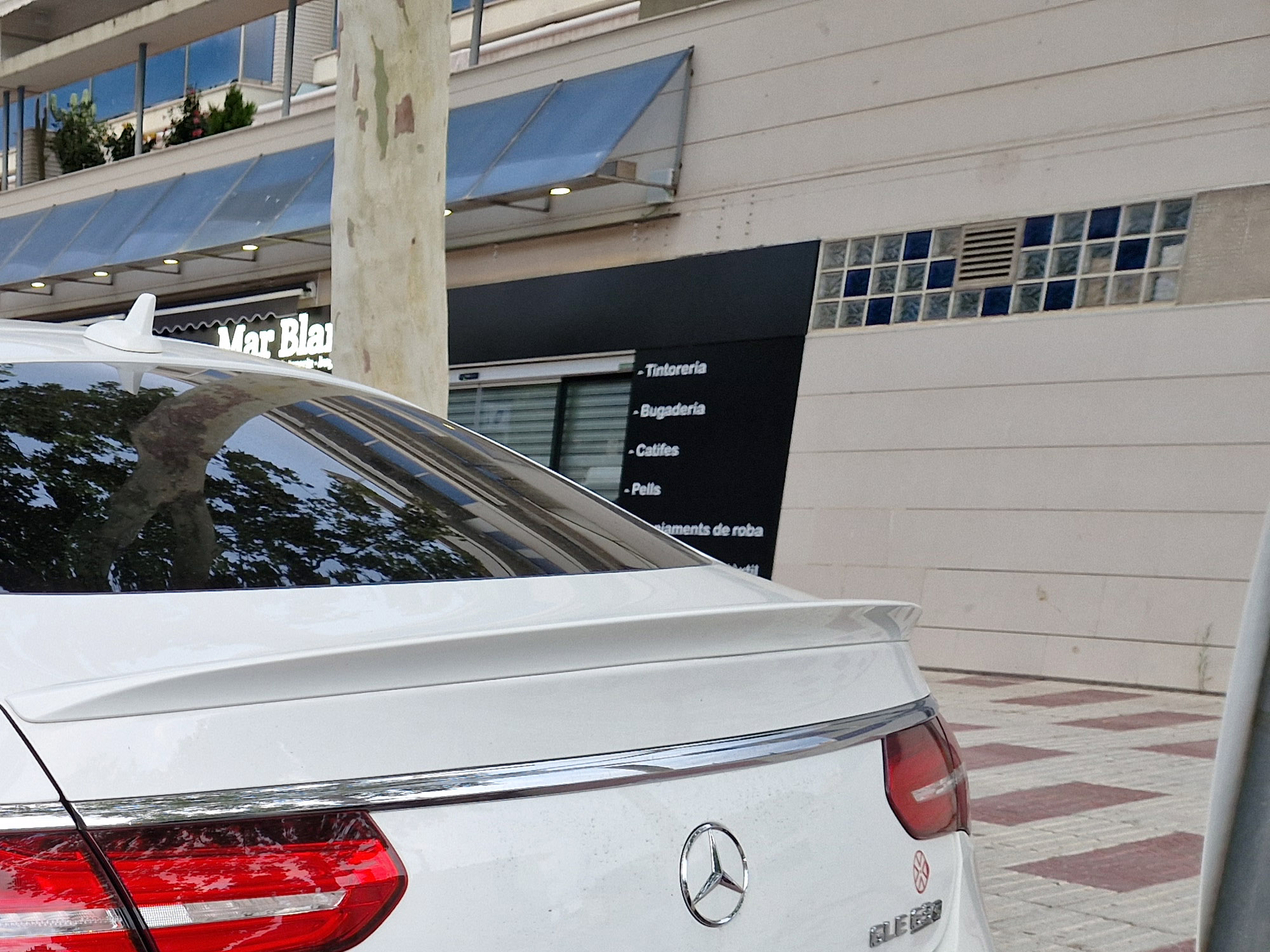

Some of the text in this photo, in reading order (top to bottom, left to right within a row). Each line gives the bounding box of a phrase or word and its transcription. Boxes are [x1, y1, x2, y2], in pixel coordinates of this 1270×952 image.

[217, 323, 275, 359] Mar
[635, 443, 680, 457] Catifes
[631, 482, 661, 496] Pells
[712, 522, 731, 537] de
[731, 523, 764, 538] roba
[869, 914, 908, 948] GLE
